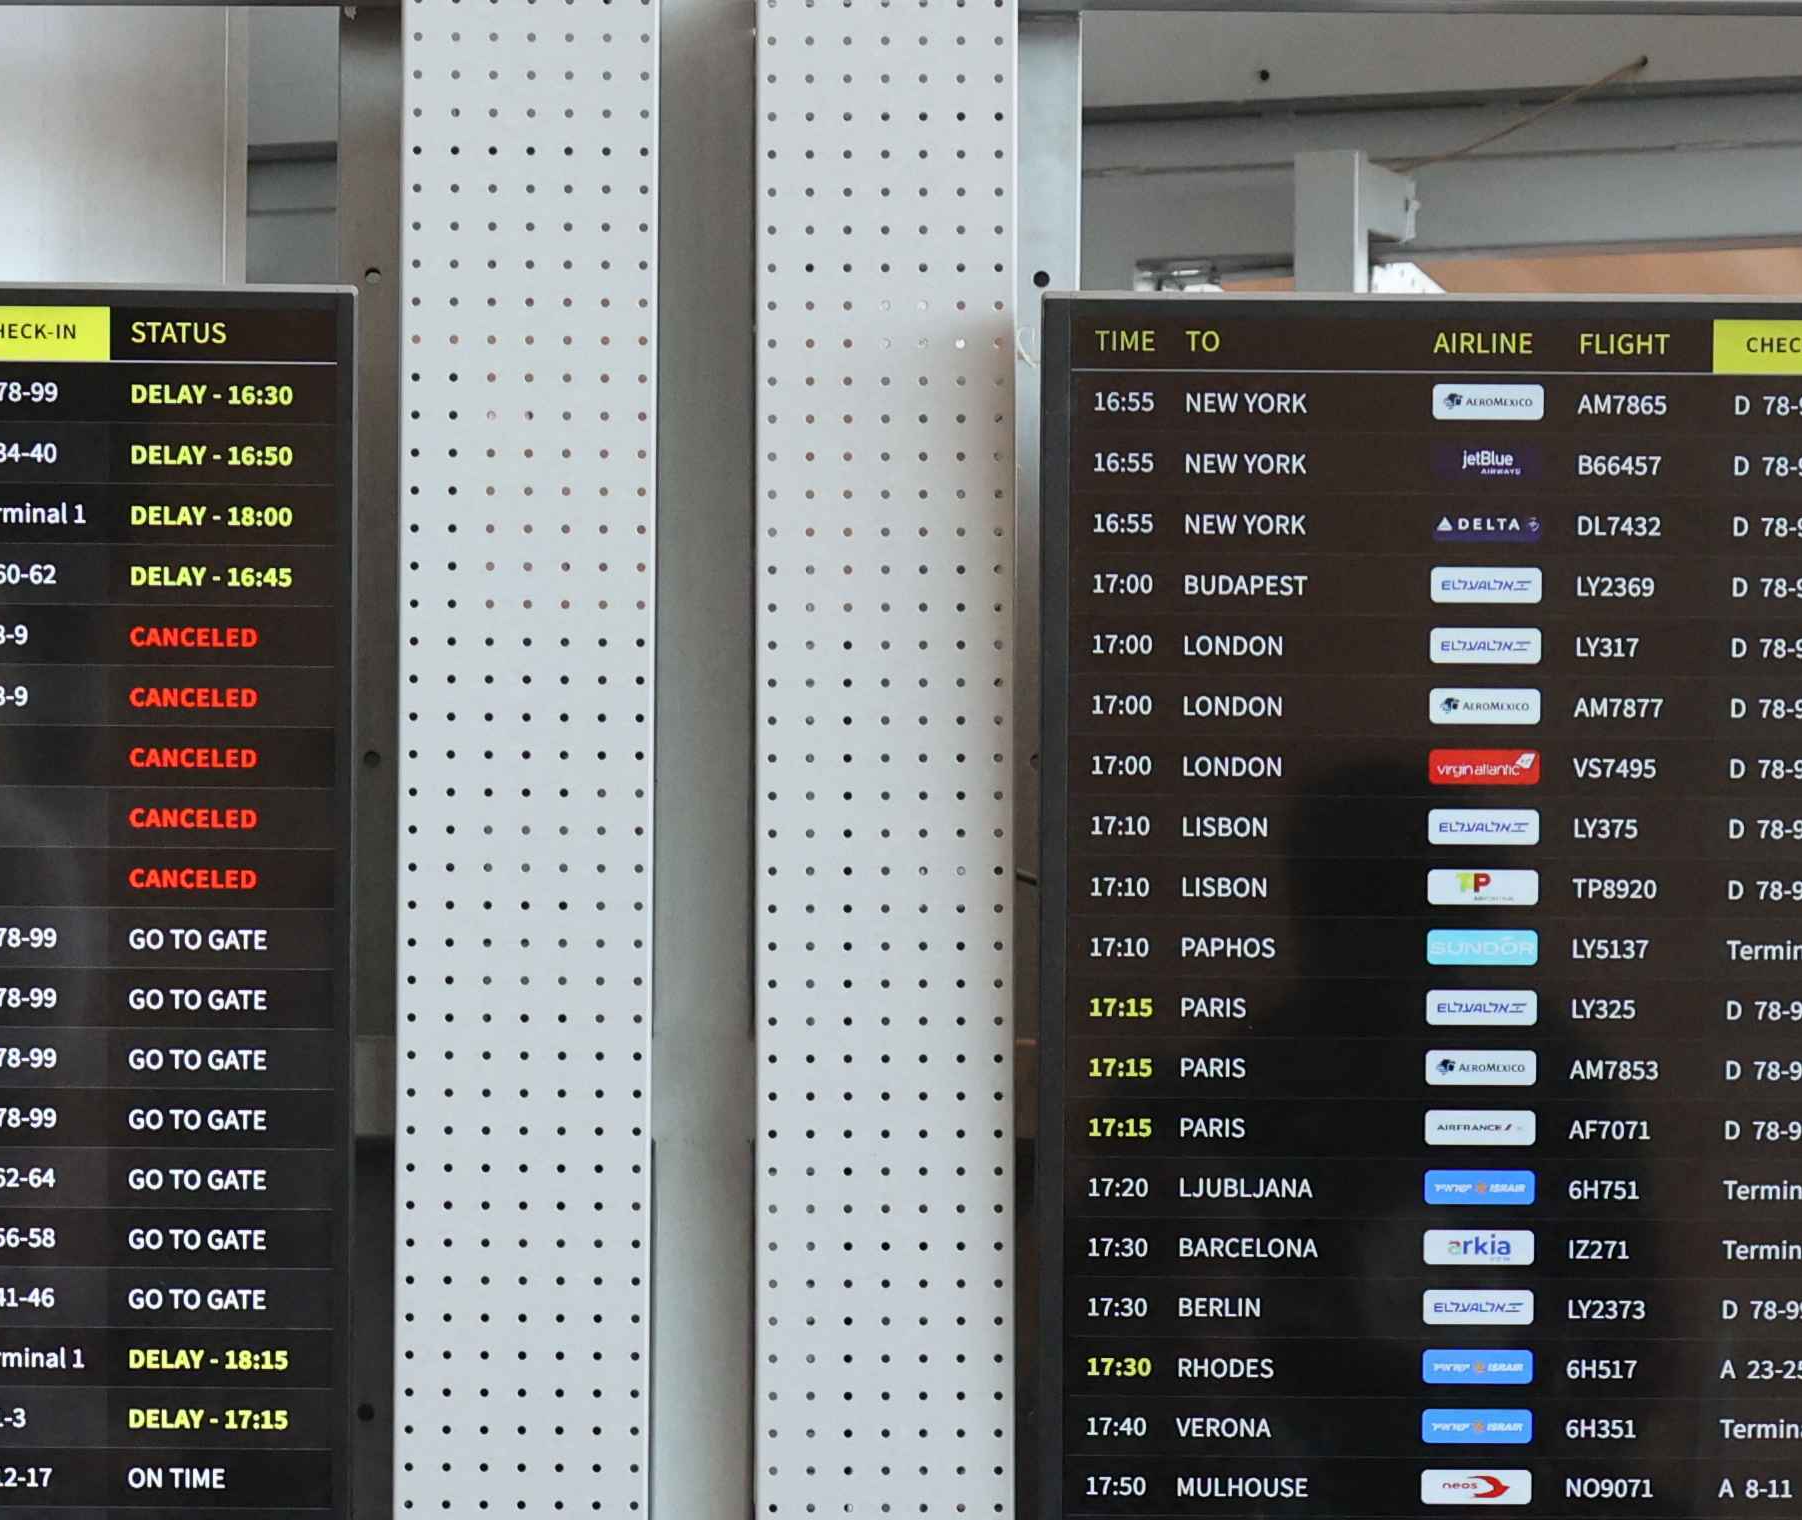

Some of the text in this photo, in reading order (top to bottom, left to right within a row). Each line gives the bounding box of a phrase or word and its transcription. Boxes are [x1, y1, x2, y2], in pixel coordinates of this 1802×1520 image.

[131, 321, 227, 344] STATUS
[1094, 330, 1156, 352] TIME
[1185, 330, 1220, 353] TO
[1433, 332, 1533, 355] AIRLINE
[1580, 333, 1671, 355] FLIGHT
[131, 383, 208, 405] DELAY
[227, 385, 294, 406] 16:30
[131, 444, 208, 466] DELAY
[227, 445, 294, 467] 16:50
[1093, 452, 1154, 473] 16:55
[1185, 453, 1238, 474] NEW
[1243, 453, 1307, 475] YORK
[1461, 449, 1515, 468] jetBlue
[1578, 454, 1662, 477] B66457
[1733, 455, 1750, 477] D
[1093, 512, 1154, 534] 16:55
[1184, 513, 1238, 535] NEW
[1242, 514, 1306, 536] YORK
[1458, 516, 1521, 531] DELTA
[1577, 515, 1662, 537] DL7432
[1733, 515, 1749, 537] D
[129, 625, 260, 649] CANCELED
[128, 747, 259, 769] CANCELED
[1091, 755, 1152, 776] 17:00
[1182, 755, 1282, 778] LONDON
[1437, 759, 1474, 778] virgin
[1572, 757, 1657, 779] VS7495
[1729, 758, 1746, 779] D
[128, 1048, 164, 1071] GO
[168, 1048, 202, 1071] TO
[207, 1049, 268, 1072] GATE
[1088, 1117, 1152, 1138] 17:15
[1180, 1117, 1246, 1139] PARIS
[1568, 1119, 1651, 1141] AF7071
[1724, 1120, 1741, 1141] D
[1088, 1237, 1148, 1258] 17:30
[1179, 1237, 1319, 1259] BARCELONA
[1447, 1233, 1512, 1257] arkia
[1568, 1239, 1630, 1260] IZ271
[128, 1288, 164, 1310] GO
[168, 1288, 202, 1311] TO
[206, 1288, 267, 1311] GATE
[127, 1467, 163, 1489] ON
[168, 1467, 226, 1489] TIME
[1085, 1476, 1147, 1497] 17:50
[1177, 1477, 1309, 1499] MULHOUSE
[1442, 1480, 1479, 1492] neos
[1565, 1477, 1654, 1499] NO9071
[1717, 1477, 1735, 1499] A
[1744, 1478, 1793, 1499] 8-11
